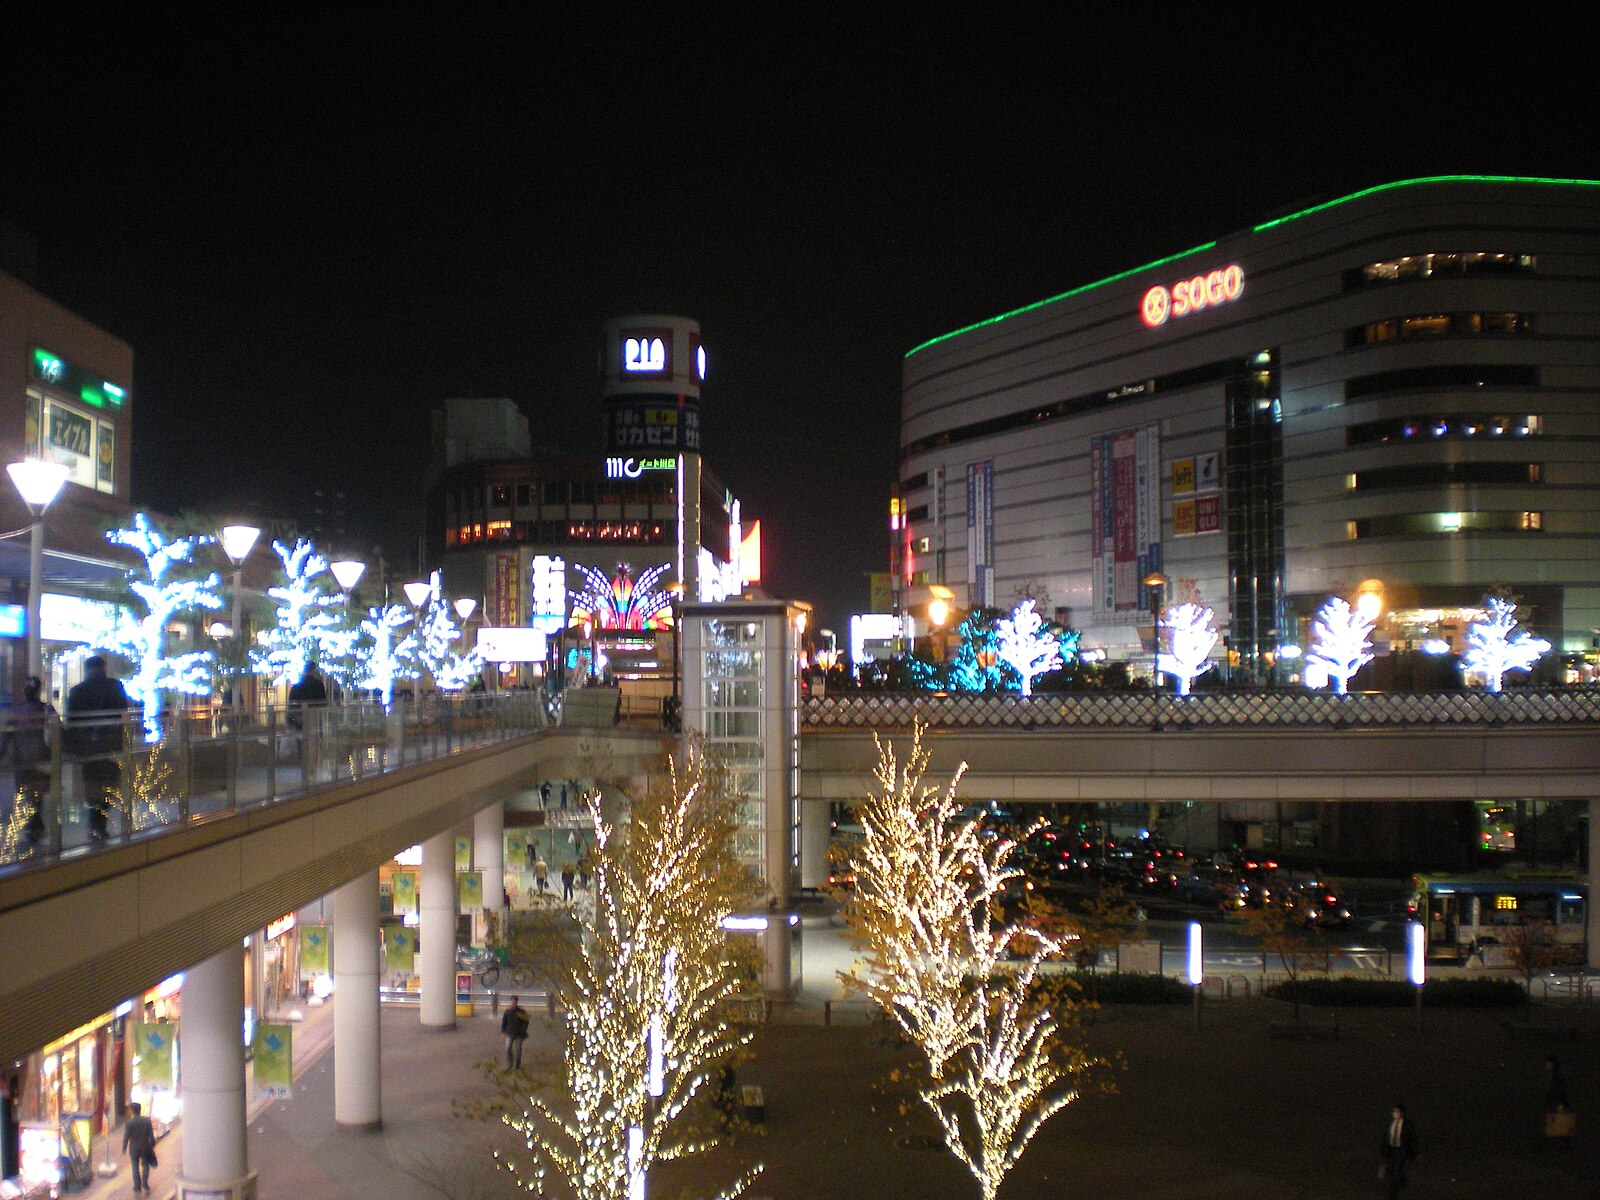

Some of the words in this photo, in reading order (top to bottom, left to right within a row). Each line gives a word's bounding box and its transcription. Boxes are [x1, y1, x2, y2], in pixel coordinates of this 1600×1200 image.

[1171, 264, 1244, 315] SOGO
[1199, 502, 1216, 514] UNI
[1199, 515, 1217, 529] QLO
